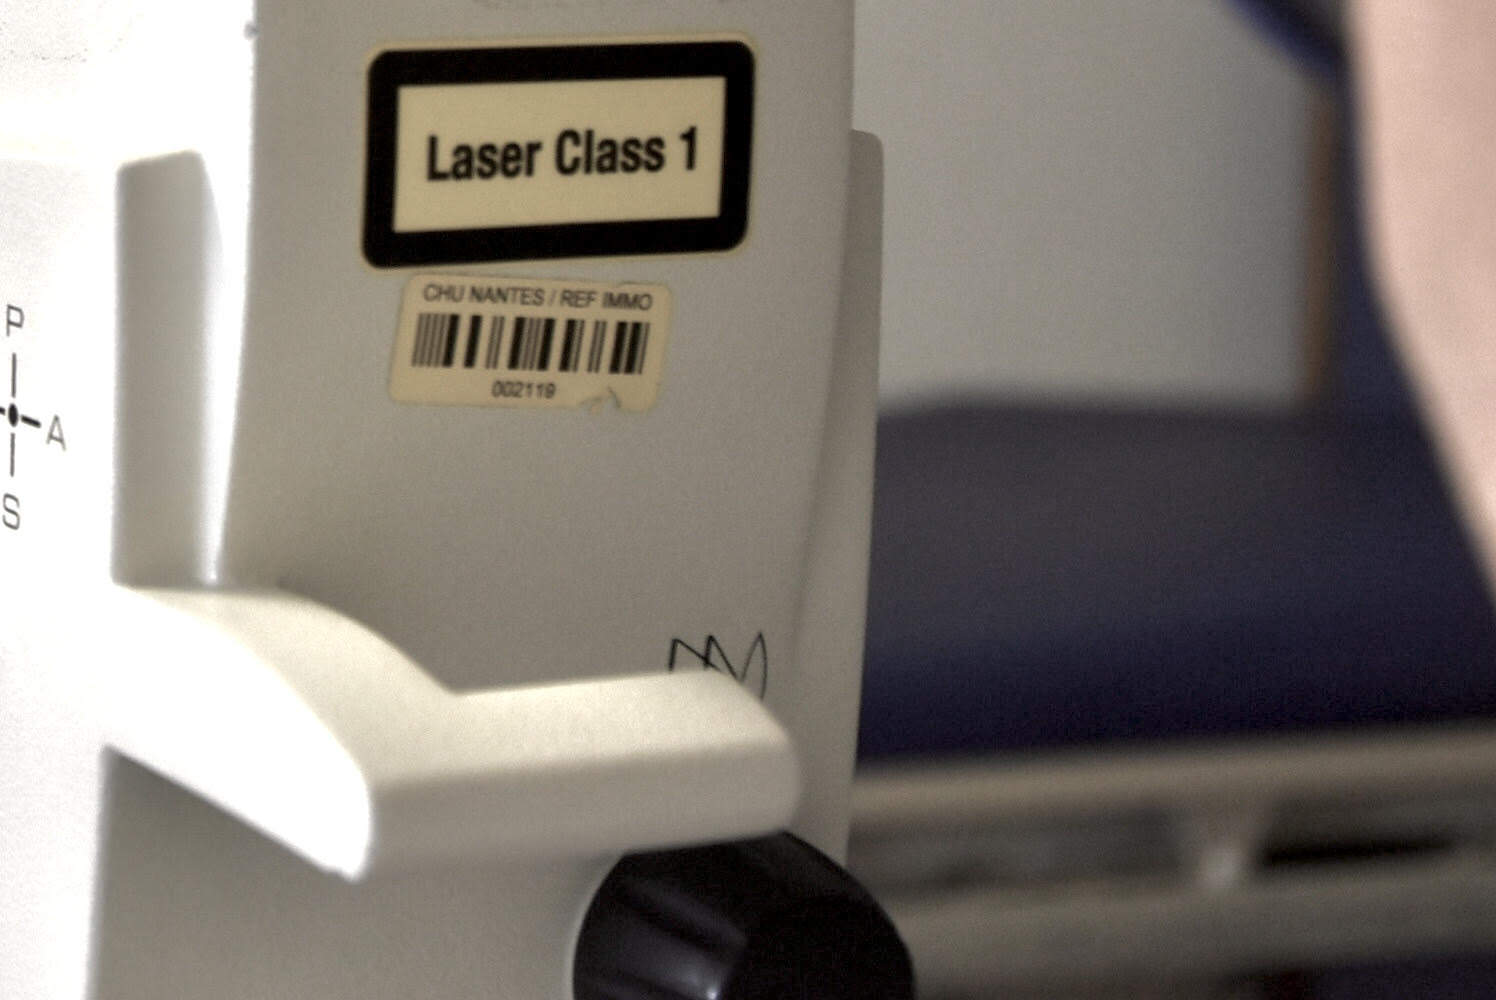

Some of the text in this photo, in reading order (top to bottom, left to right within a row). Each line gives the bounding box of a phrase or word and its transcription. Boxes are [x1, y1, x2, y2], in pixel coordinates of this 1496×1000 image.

[426, 126, 698, 182] Laser Class 1
[423, 283, 465, 303] CHU
[469, 286, 546, 307] NANTES
[559, 289, 598, 310] REF
[602, 292, 653, 311] IMMO
[6, 303, 24, 337] P
[491, 380, 556, 400] 002119
[46, 414, 67, 451] A
[2, 492, 20, 531] S
